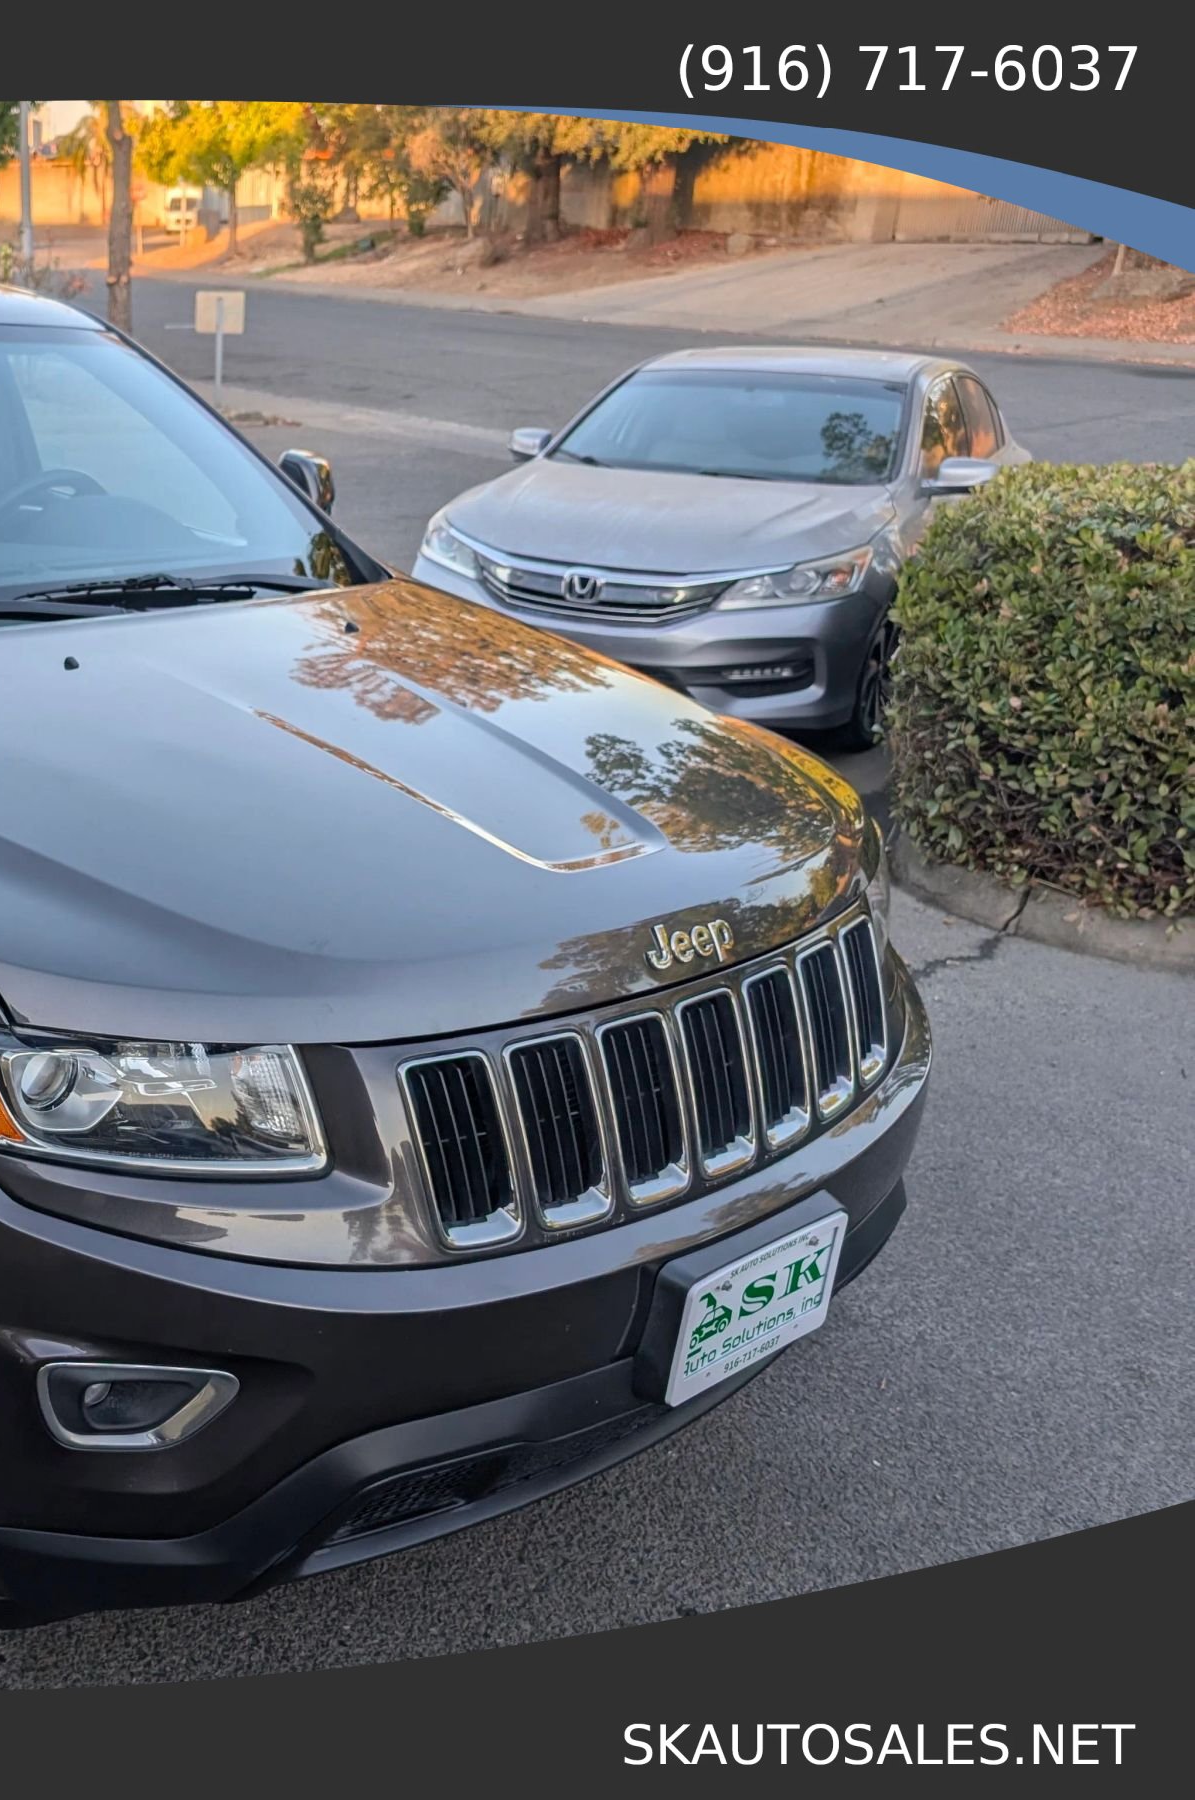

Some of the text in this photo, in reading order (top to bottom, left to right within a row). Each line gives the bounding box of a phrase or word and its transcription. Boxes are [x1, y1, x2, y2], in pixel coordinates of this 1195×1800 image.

[644, 919, 734, 970] Jeep
[738, 1257, 759, 1273] AUTO
[758, 1238, 798, 1264] SOLUTIONS
[797, 1231, 812, 1245] INC
[738, 1243, 832, 1320] SK
[723, 1334, 781, 1374] 916-717-6037
